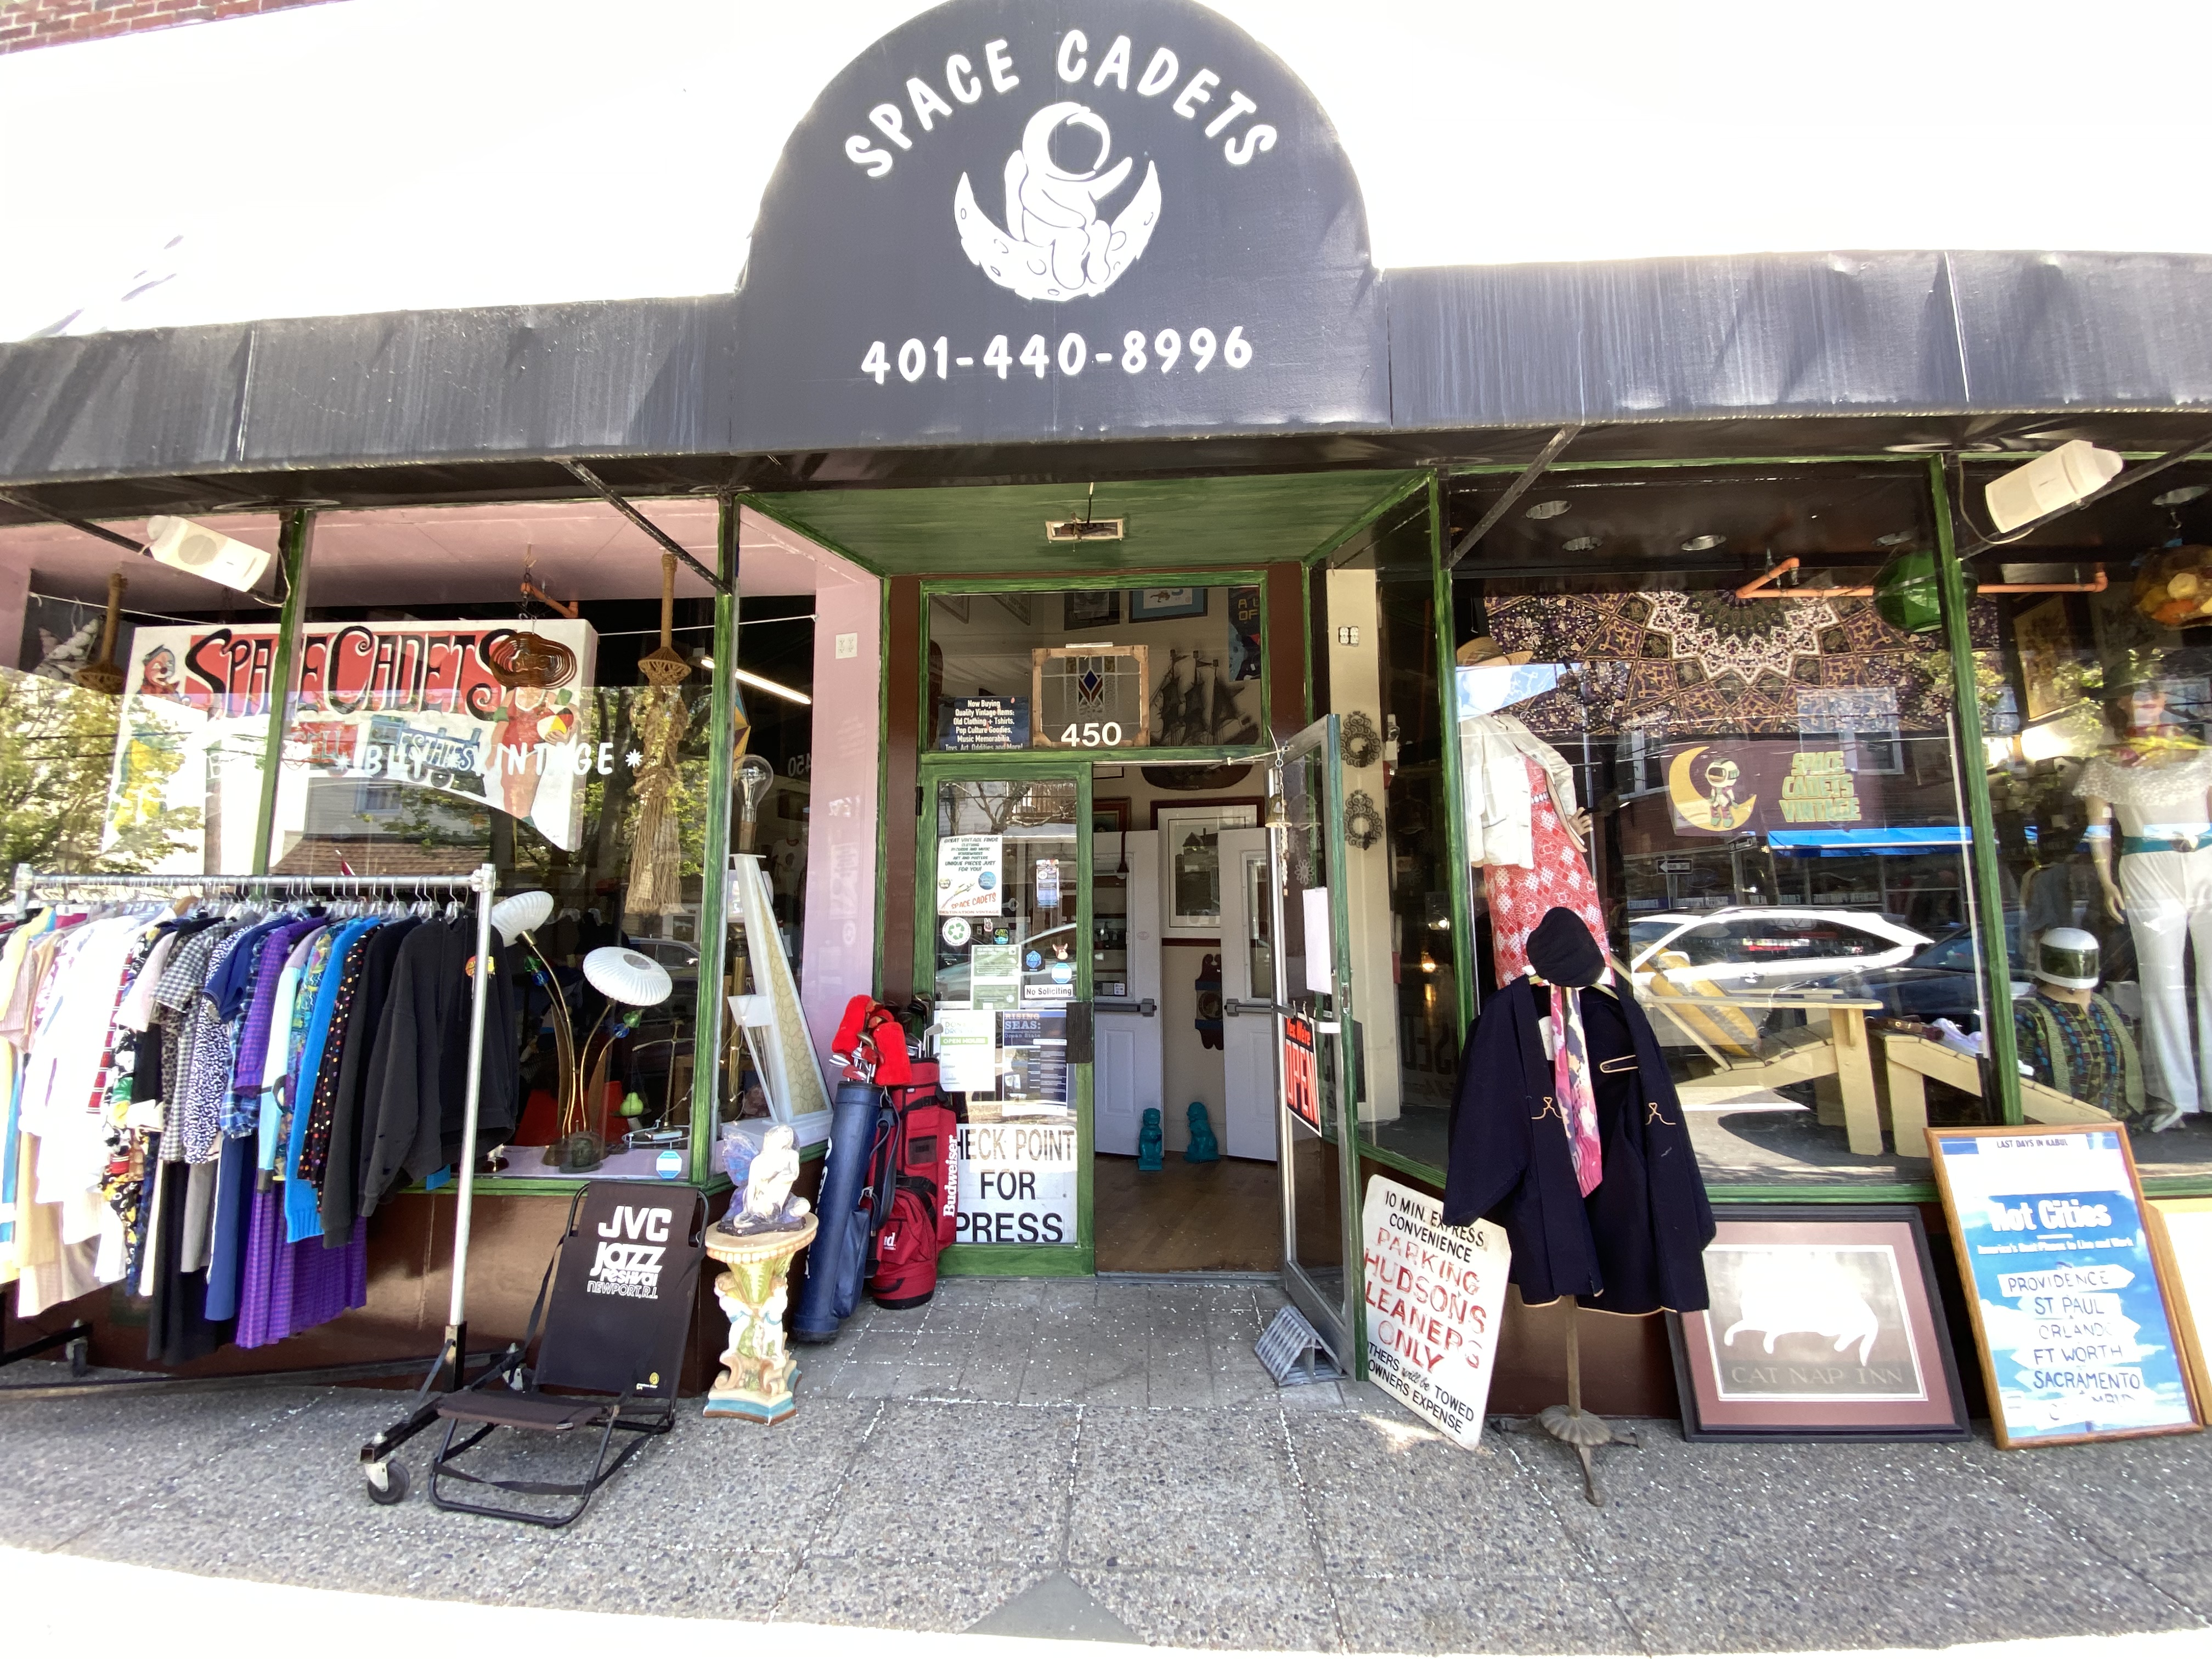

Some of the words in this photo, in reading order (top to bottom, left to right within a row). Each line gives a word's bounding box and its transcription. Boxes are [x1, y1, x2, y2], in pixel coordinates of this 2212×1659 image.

[845, 38, 1019, 177] SPACE
[1057, 29, 1278, 166] CADETS
[861, 326, 1253, 384] 401-440-8996
[185, 628, 328, 722] SPAE
[955, 709, 974, 717] Quality
[975, 709, 996, 717] Vintage
[981, 699, 1001, 708] Buying
[964, 718, 986, 726] Clothing
[1060, 722, 1122, 747] 450
[1791, 751, 1845, 776] SPACE
[1782, 774, 1854, 799] CADETS
[1779, 798, 1861, 822] VINTAGE
[951, 900, 970, 909] SPACE
[972, 892, 996, 905] CADETS
[1038, 987, 1072, 996] Soliciting
[1005, 1020, 1041, 1029] SEAS:
[1285, 1038, 1319, 1125] OPEN
[957, 1128, 1006, 1161] HECK
[1015, 1128, 1075, 1161] POINT
[1996, 1140, 2013, 1148] LAST
[943, 1135, 958, 1218] Budweiser
[980, 1169, 1036, 1200] FOR
[598, 1205, 672, 1242] JVC
[1385, 1190, 1396, 1207] 10
[1400, 1197, 1426, 1222] MIN.
[1431, 1210, 1484, 1247] EXRESS
[1390, 1213, 1472, 1263] CONVENIENCE
[1378, 1227, 1480, 1295] PARKING
[1364, 1248, 1487, 1334] HUDSONS
[2008, 1269, 2109, 1292] PROVIDENCE
[2034, 1297, 2052, 1314] ST
[2063, 1296, 2104, 1314] PAUL
[1364, 1280, 1482, 1369] LEANERS
[1378, 1320, 1444, 1373] ONLY
[2034, 1347, 2055, 1365] FT
[2061, 1345, 2123, 1362] WORTH
[1367, 1341, 1400, 1372] THERS
[1402, 1367, 1421, 1384] will
[1420, 1377, 1431, 1391] be
[1435, 1385, 1474, 1422] TOWED
[1731, 1367, 1778, 1384] CAT
[1788, 1367, 1844, 1385] NAP
[1857, 1367, 1904, 1385] INN
[2033, 1370, 2140, 1389] SACRAMENTO
[1368, 1359, 1410, 1396] OWNERS
[1413, 1390, 1463, 1435] EXPENSE
